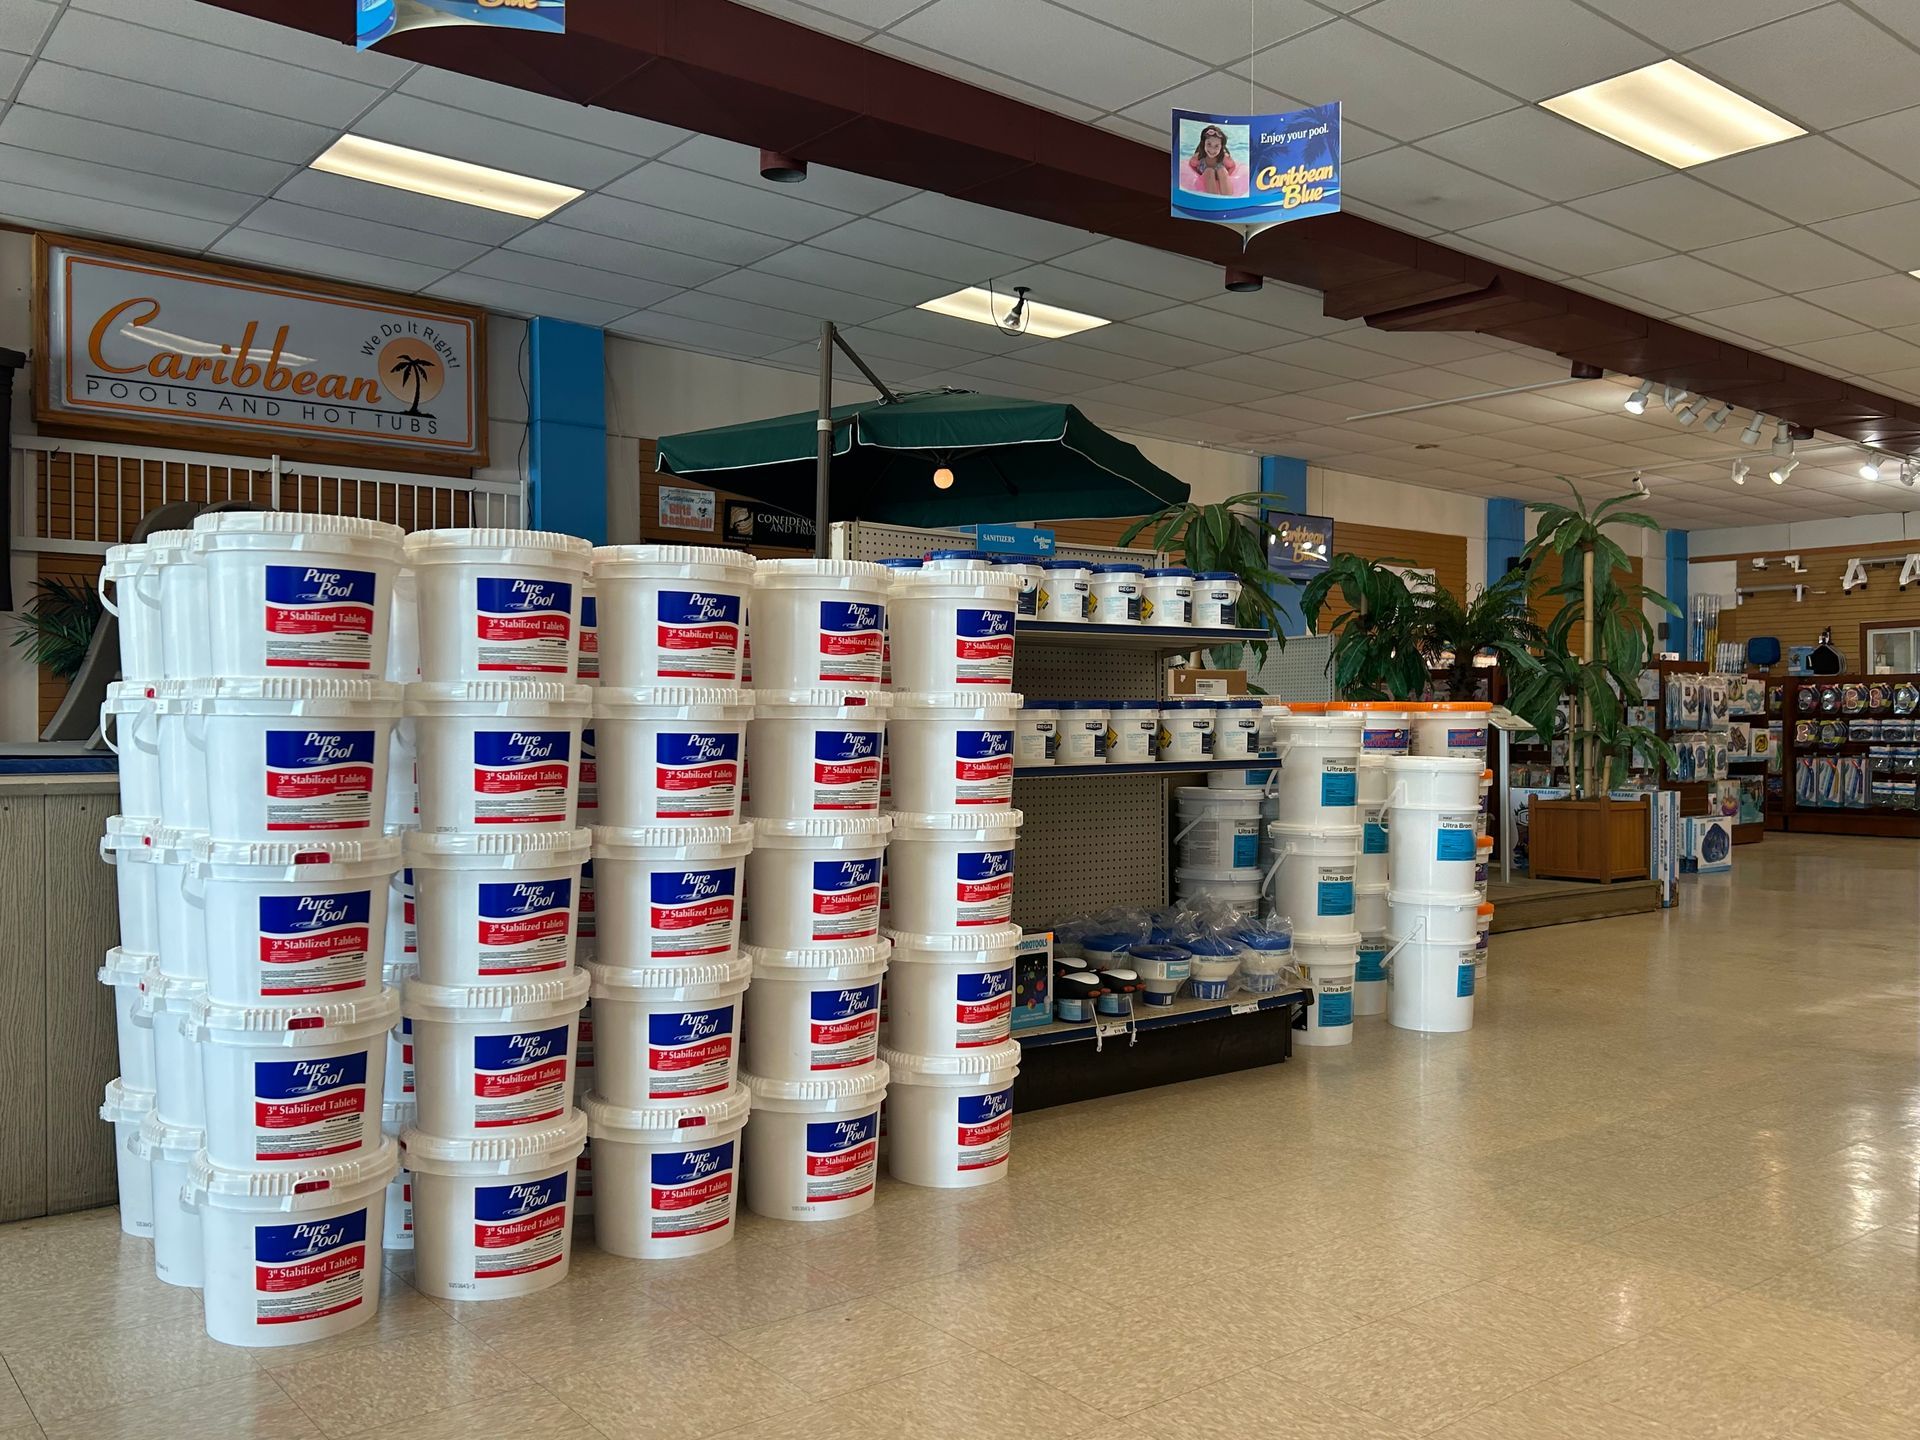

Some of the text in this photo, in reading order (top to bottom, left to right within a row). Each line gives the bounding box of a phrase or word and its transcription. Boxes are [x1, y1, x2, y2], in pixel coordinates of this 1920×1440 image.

[1260, 123, 1329, 146] Enjoy your pool.
[1255, 165, 1334, 191] Caribbean
[1283, 184, 1323, 210] Blue
[88, 297, 382, 404] Caribbean
[361, 321, 461, 369] We Do It Right!
[86, 379, 438, 435] POOLS AND HOT TUBS
[769, 524, 793, 534] AND
[982, 533, 1016, 544] SANITIZERS
[303, 569, 340, 584] Pure
[317, 583, 354, 598] Pool
[511, 580, 543, 594] Pure
[523, 593, 554, 607] Pool
[689, 594, 717, 606] Pure
[699, 605, 726, 619] Pool
[848, 604, 869, 615] Pure
[982, 611, 1002, 621] Pure
[289, 611, 336, 622] Stabilized
[339, 613, 366, 623] Tablets
[855, 614, 875, 627] Pool
[500, 619, 540, 629] Stabilized
[990, 620, 1008, 633] Pool
[678, 630, 713, 639] Stabilized
[304, 732, 341, 745] Pure
[509, 733, 540, 745] Pure
[688, 735, 715, 746] Pure
[843, 733, 865, 743] Pure
[982, 732, 1001, 742] Pure
[318, 744, 354, 760] Pool
[520, 743, 552, 759] Pool
[698, 744, 725, 759] Pool
[851, 742, 872, 755] Pool
[990, 740, 1007, 753] Pool
[290, 774, 336, 784] Stabilized
[340, 774, 366, 783] Tablets
[497, 772, 537, 780] Stabilized
[676, 770, 712, 778] Stabilized
[983, 853, 1002, 863] Pure
[841, 862, 864, 872] Pure
[990, 860, 1007, 874] Pool
[682, 873, 710, 885] Pure
[850, 869, 871, 884] Pool
[513, 884, 543, 896] Pure
[693, 880, 720, 897] Pool
[297, 897, 334, 911] Pure
[524, 892, 554, 909] Pool
[311, 906, 348, 924] Pool
[671, 907, 707, 917] Stabilized
[501, 921, 540, 932] Stabilized
[284, 937, 330, 949] Stabilized
[334, 935, 361, 945] Tablets
[1016, 938, 1048, 951] YDROTOOLS
[982, 973, 1001, 984] Pure
[990, 980, 1006, 994] Pool
[839, 990, 862, 1002] Pure
[847, 996, 869, 1013] Pool
[680, 1014, 708, 1026] Pure
[691, 1020, 718, 1037] Pool
[509, 1035, 540, 1048] Pure
[520, 1042, 551, 1060] Pool
[669, 1047, 705, 1059] Stabilized
[293, 1062, 330, 1076] Pure
[307, 1069, 344, 1089] Pool
[497, 1071, 537, 1084] Stabilized
[279, 1101, 326, 1114] Stabilized
[329, 1098, 357, 1108] Tablets
[983, 1094, 1001, 1105] Pure
[991, 1100, 1006, 1115] Pool
[835, 1122, 859, 1133] Pure
[844, 1127, 866, 1144] Pool
[682, 1152, 710, 1164] Pure
[693, 1157, 719, 1176] Pool
[509, 1185, 539, 1199] Pure
[672, 1185, 707, 1198] Stabilized
[521, 1191, 550, 1210] Pool
[293, 1223, 330, 1239] Pure
[497, 1220, 536, 1235] Stabilized
[307, 1229, 344, 1251] Pool
[280, 1261, 327, 1277] Stabilized
[330, 1257, 357, 1268] Tablets
